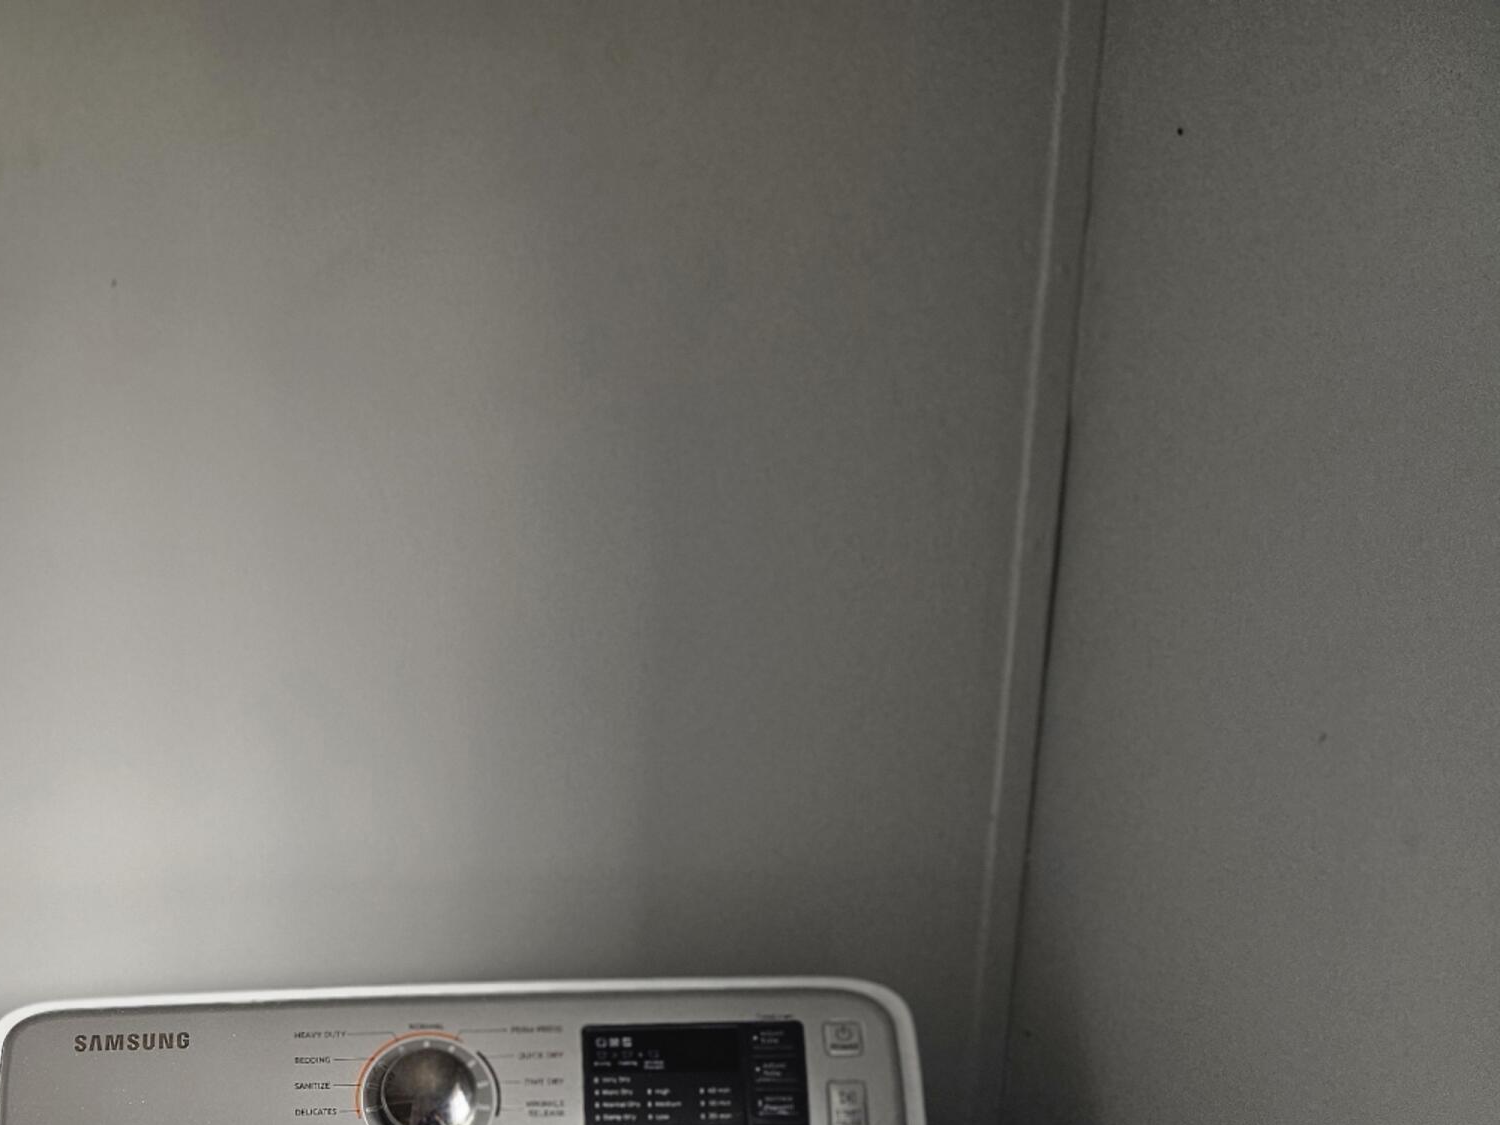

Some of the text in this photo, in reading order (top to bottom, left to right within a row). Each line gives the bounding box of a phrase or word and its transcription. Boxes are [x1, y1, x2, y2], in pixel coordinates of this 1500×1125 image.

[294, 1030, 346, 1039] HEAVY DUTY
[74, 1032, 190, 1052] SAMSUNG
[294, 1081, 331, 1090] SANITIZE
[295, 1107, 337, 1116] DELICATES
